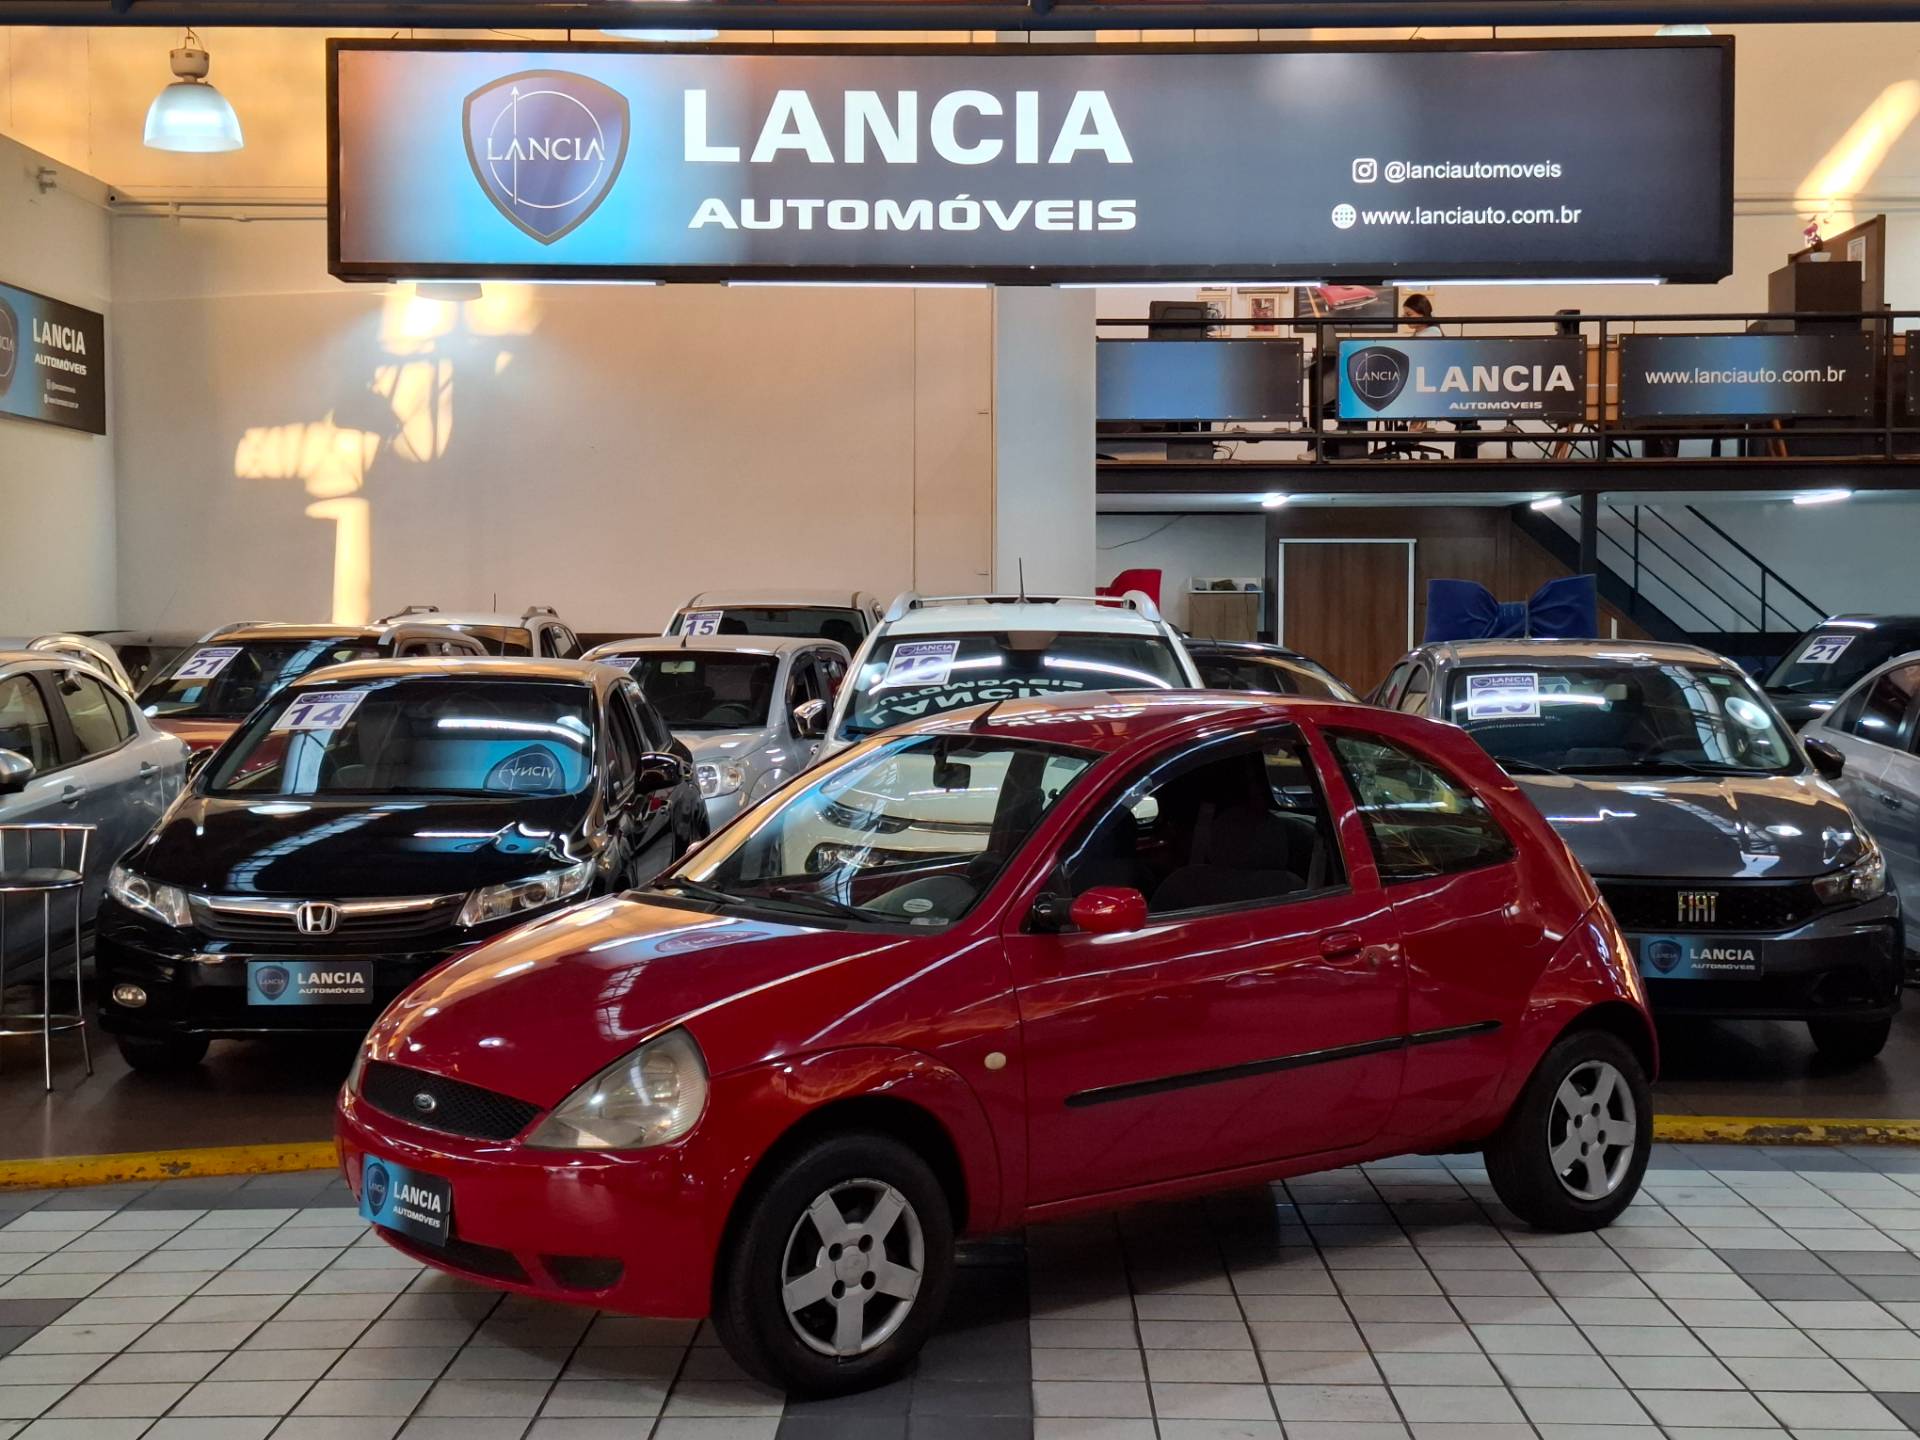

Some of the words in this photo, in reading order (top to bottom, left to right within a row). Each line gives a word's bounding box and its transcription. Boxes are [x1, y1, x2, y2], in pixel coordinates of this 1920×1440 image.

[684, 89, 1134, 165] LANCIA
[486, 137, 606, 161] LANCIA
[1384, 160, 1562, 183] @lanciautomoveis
[687, 194, 1137, 231] AUTOMÓVEIS
[1361, 205, 1582, 225] www.lanciauto.com.br
[32, 317, 86, 356] LANCIA
[1355, 370, 1399, 382] LANCIA
[1415, 365, 1575, 393] LANCIA
[1645, 366, 1846, 384] www.lanciauto.com.br
[1448, 400, 1543, 410] AUTOMÓVEIS
[686, 620, 714, 636] 15
[1804, 645, 1842, 660] 21
[180, 659, 224, 676] 21
[290, 703, 347, 726] 14
[1677, 891, 1719, 922] FIAT
[1689, 948, 1755, 961] LANCIA
[297, 972, 365, 985] LANCIA
[393, 1180, 442, 1213] LANCIA
